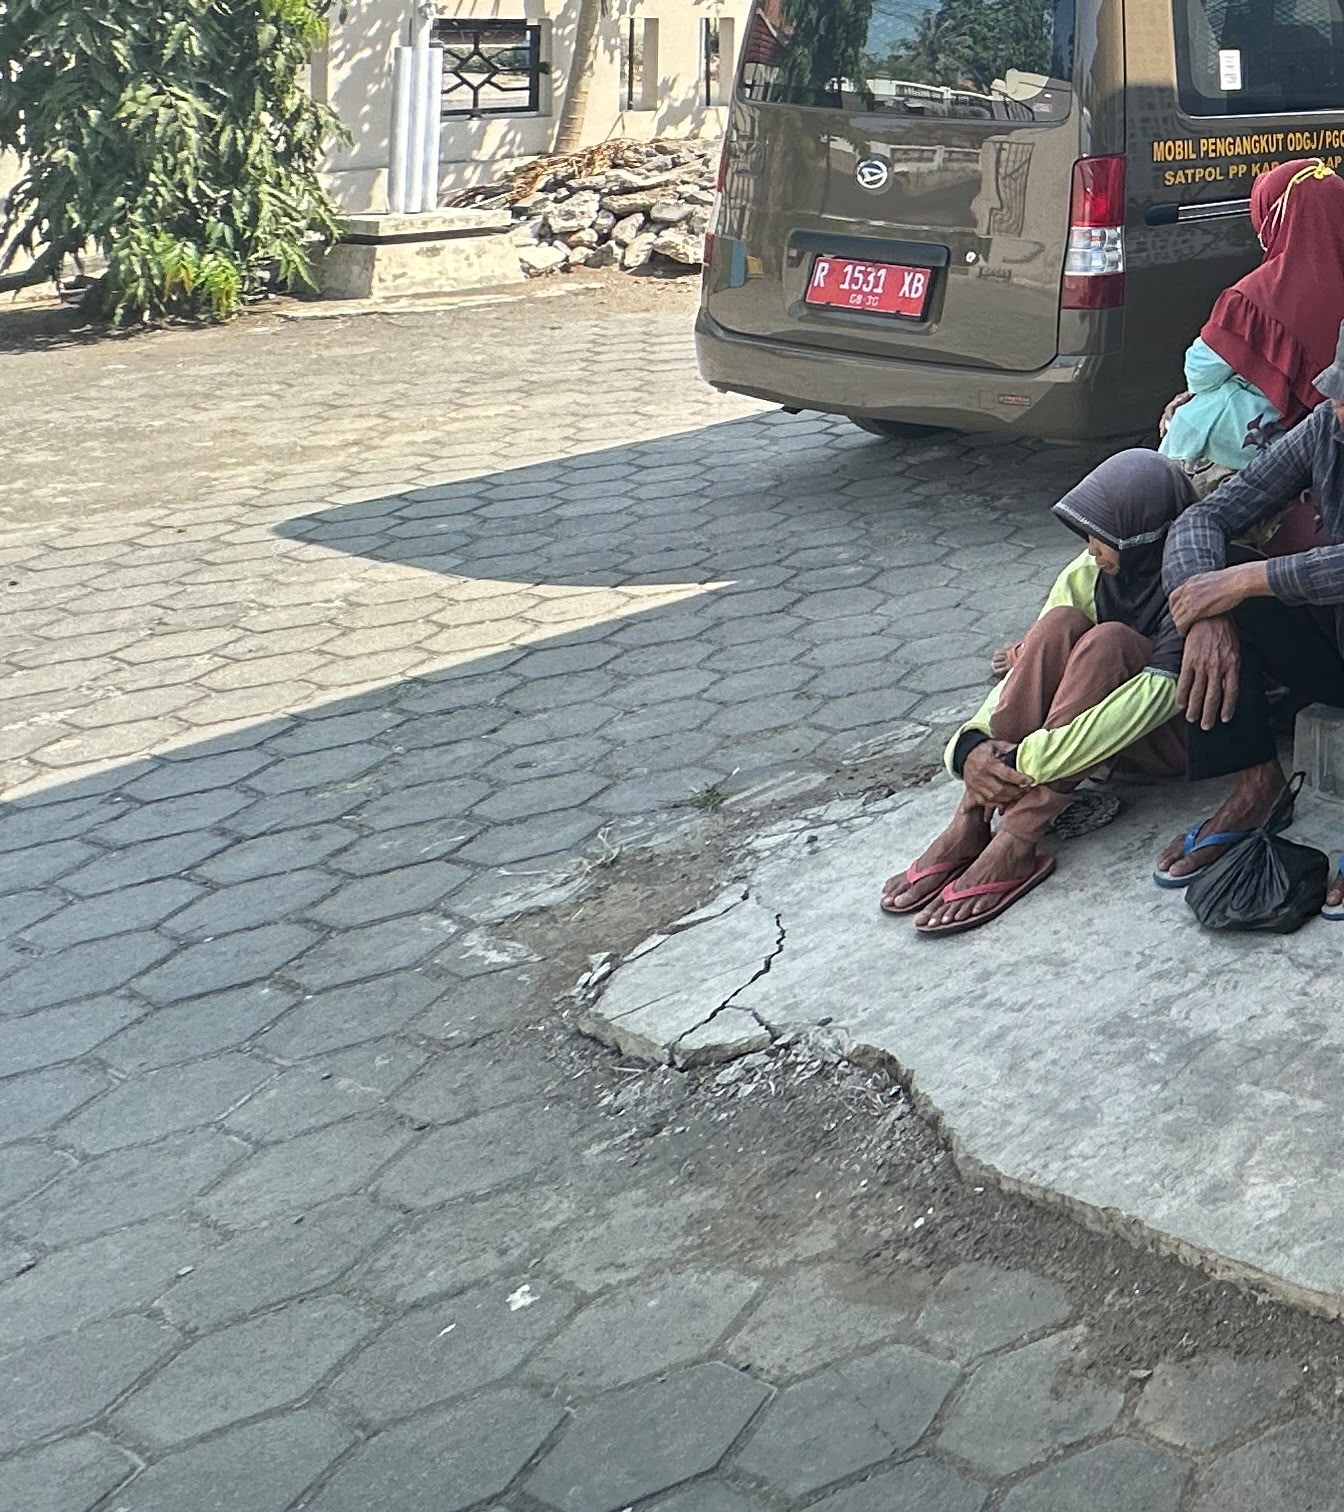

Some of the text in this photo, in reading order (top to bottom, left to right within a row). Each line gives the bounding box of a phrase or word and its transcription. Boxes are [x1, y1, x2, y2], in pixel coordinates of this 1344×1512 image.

[1153, 140, 1197, 162] MOBIL
[1199, 133, 1285, 159] PENGANGKUT
[1164, 167, 1225, 186] SATPOL
[1228, 164, 1248, 179] PP
[813, 262, 925, 298] R 1531 XB
